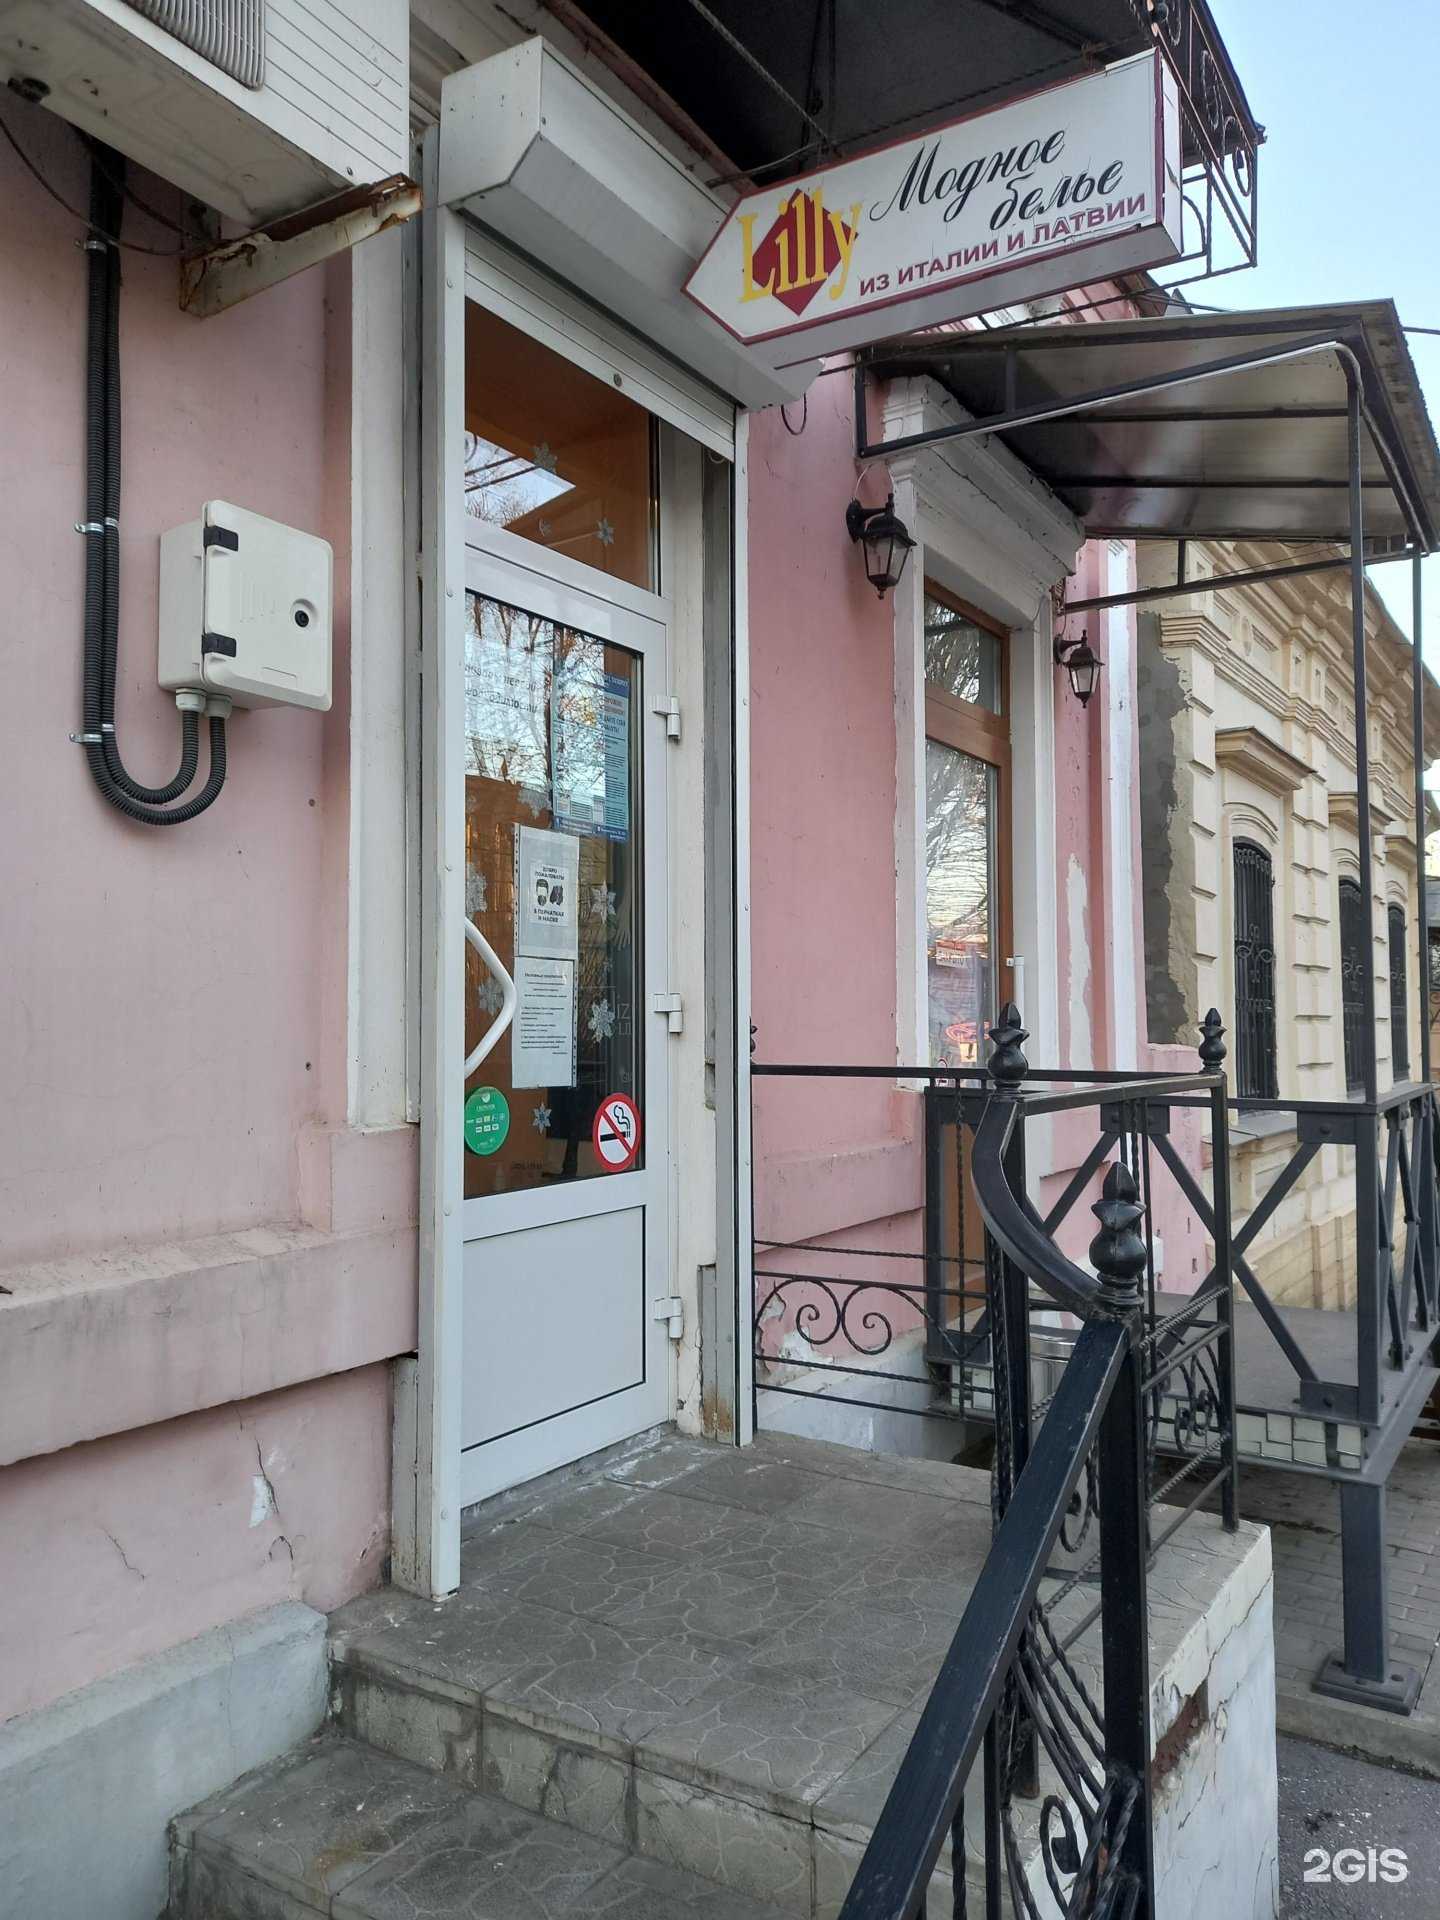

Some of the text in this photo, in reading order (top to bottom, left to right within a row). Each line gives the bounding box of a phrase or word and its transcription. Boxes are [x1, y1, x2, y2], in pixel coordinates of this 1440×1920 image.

[869, 129, 1066, 223] Модное
[989, 160, 1124, 231] белье
[736, 186, 862, 303] Lilly
[859, 192, 1147, 297] ИЗ ИТАЛИИ И ЛАТВИИ
